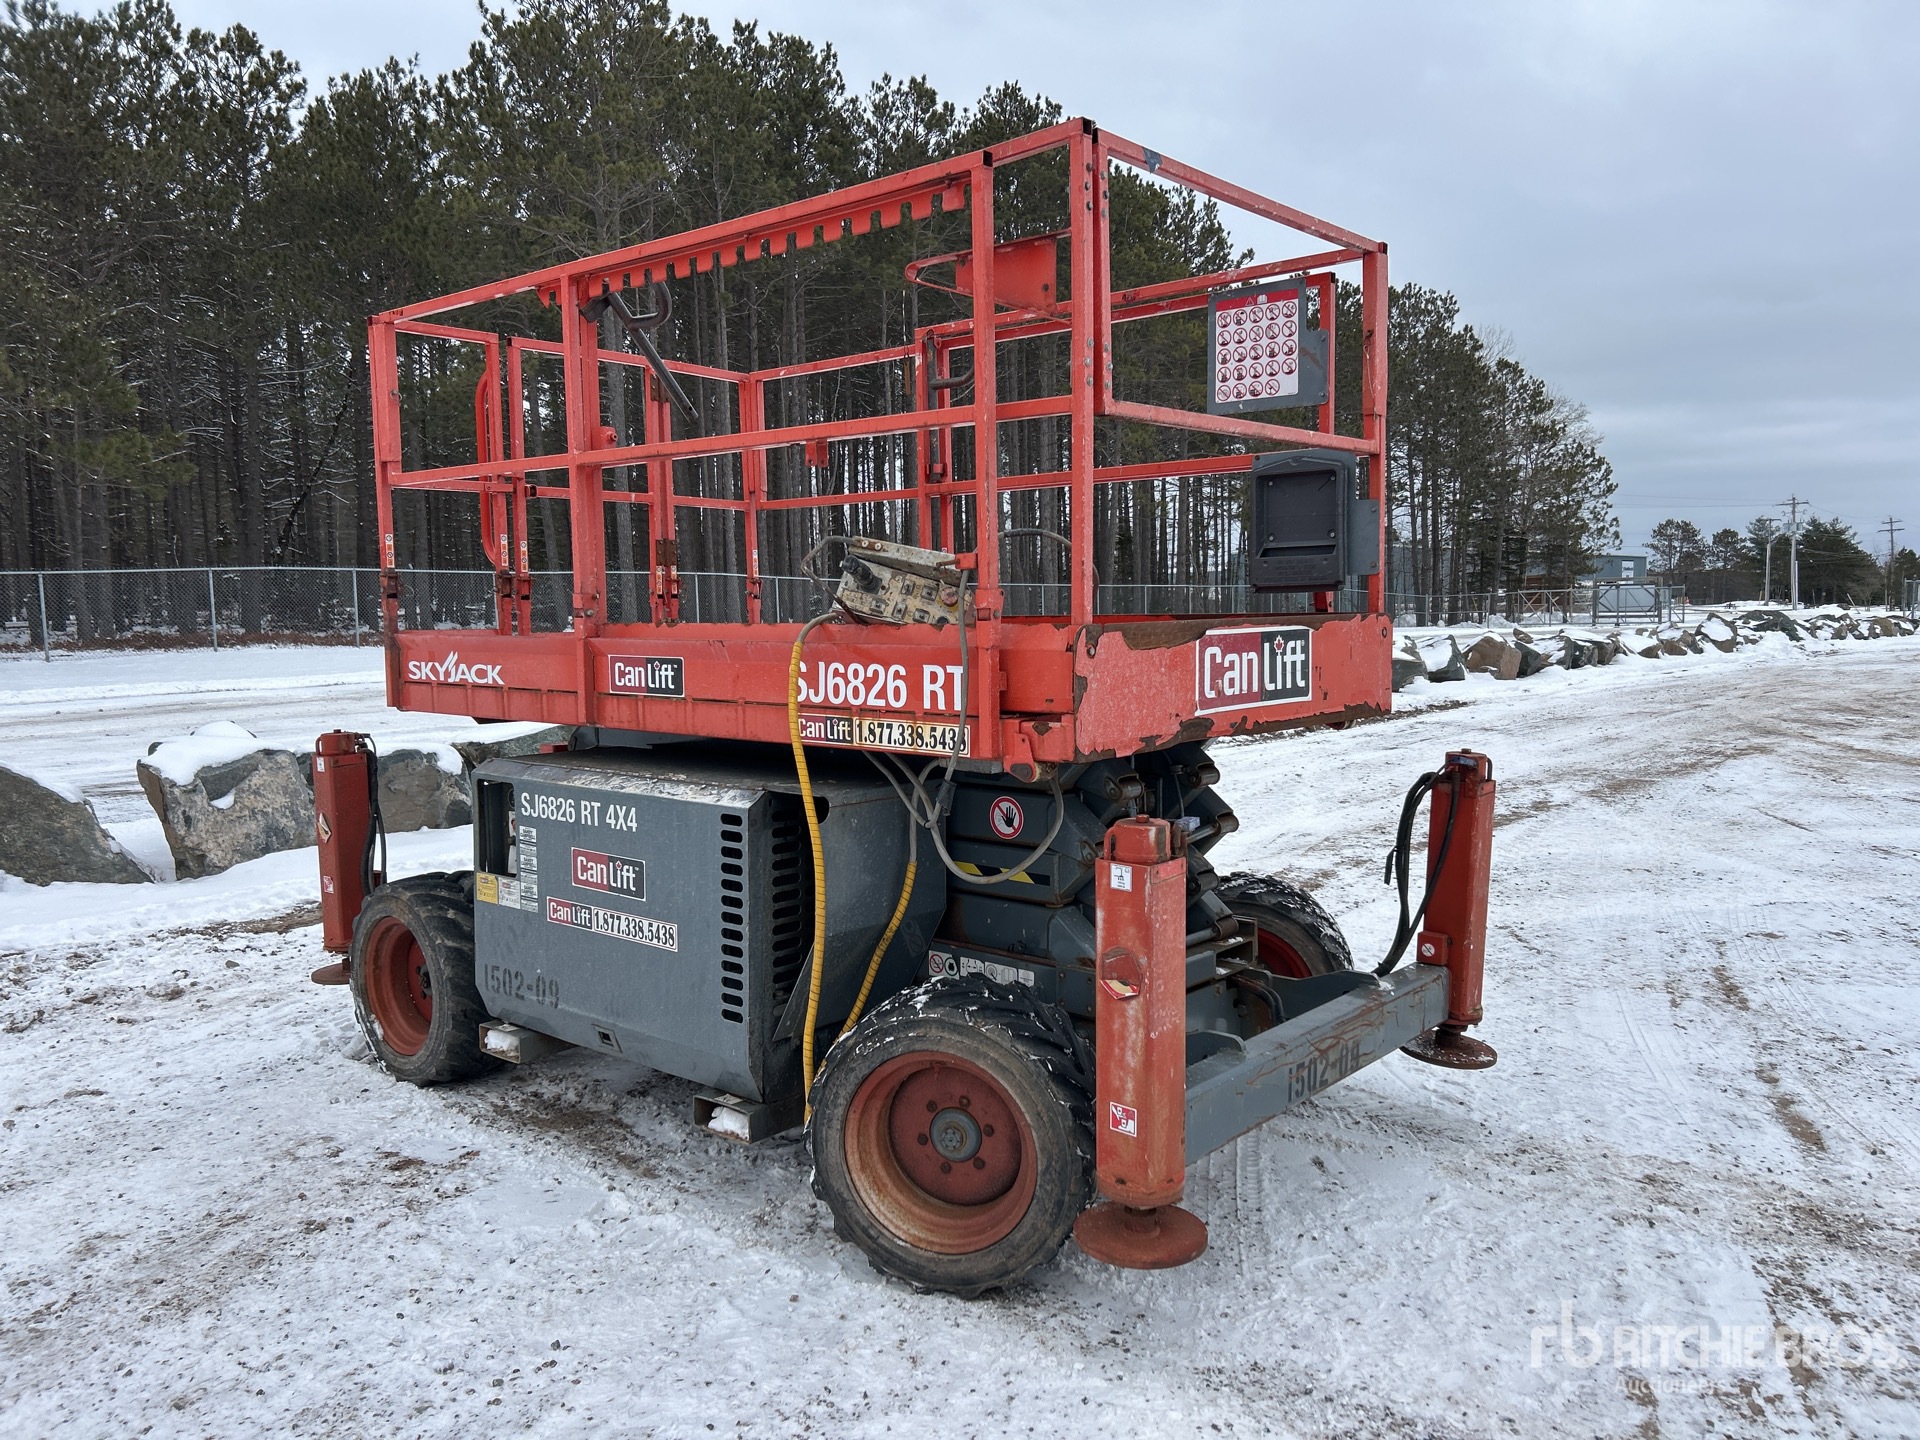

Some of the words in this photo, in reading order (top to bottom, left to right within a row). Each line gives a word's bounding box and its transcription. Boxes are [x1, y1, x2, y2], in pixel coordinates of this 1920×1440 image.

[408, 651, 505, 685] SKYJACK
[614, 660, 675, 689] CanLift
[1203, 634, 1306, 699] CanLift
[922, 664, 964, 711] RT
[798, 717, 851, 741] CanLift
[521, 792, 576, 823] SJ6826
[580, 800, 601, 827] RT
[605, 804, 638, 832] 4X4
[577, 855, 636, 892] CanLift
[549, 902, 591, 927] CanLift
[594, 910, 675, 947] 1.877.338.5438
